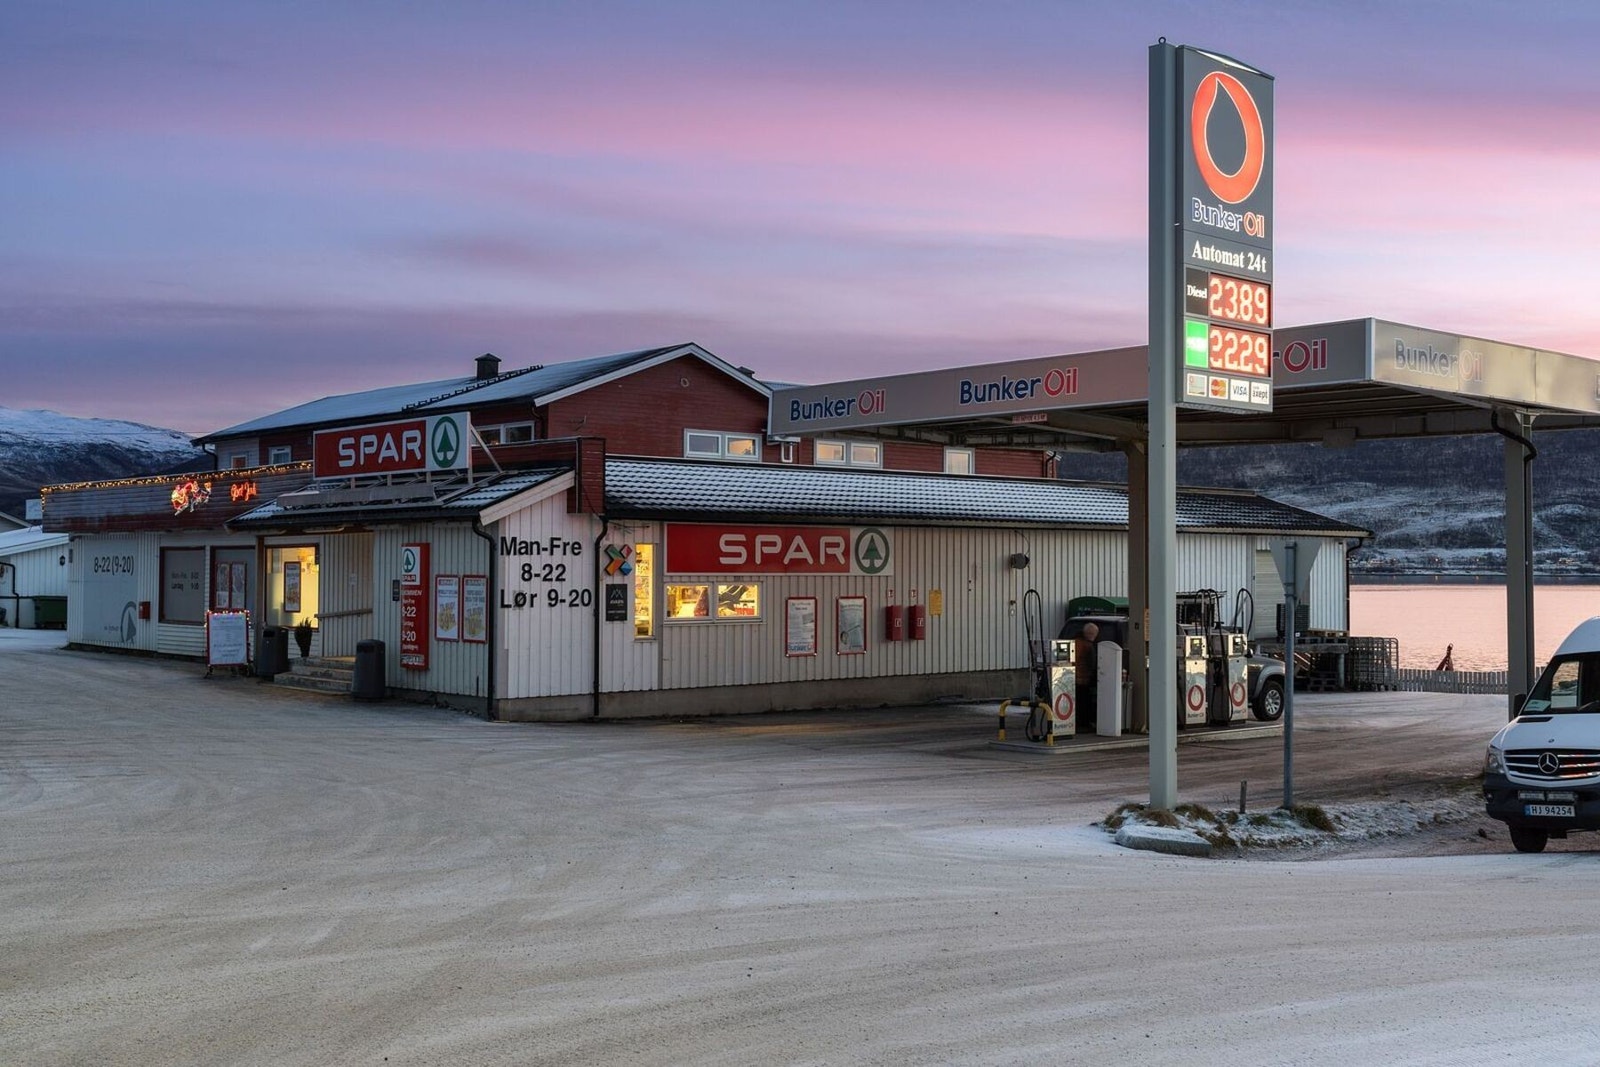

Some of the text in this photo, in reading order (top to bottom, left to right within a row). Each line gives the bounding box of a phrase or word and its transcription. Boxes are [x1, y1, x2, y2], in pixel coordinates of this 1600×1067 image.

[1192, 197, 1265, 238] Bunker Oil
[1192, 240, 1267, 273] Automat 24t
[1187, 284, 1208, 299] Diesel
[1283, 338, 1328, 373] Oil
[1393, 337, 1484, 382] Bunker Oil
[959, 367, 1079, 405] Bunker Oil
[1232, 385, 1248, 396] VISA
[790, 389, 886, 422] Bunker Oil
[338, 429, 422, 468] SPAR
[500, 536, 582, 556] Man-Fre
[719, 533, 846, 565] SPAR
[521, 563, 567, 582] 8-22
[500, 589, 538, 609] Lør
[547, 588, 592, 608] 9-20
